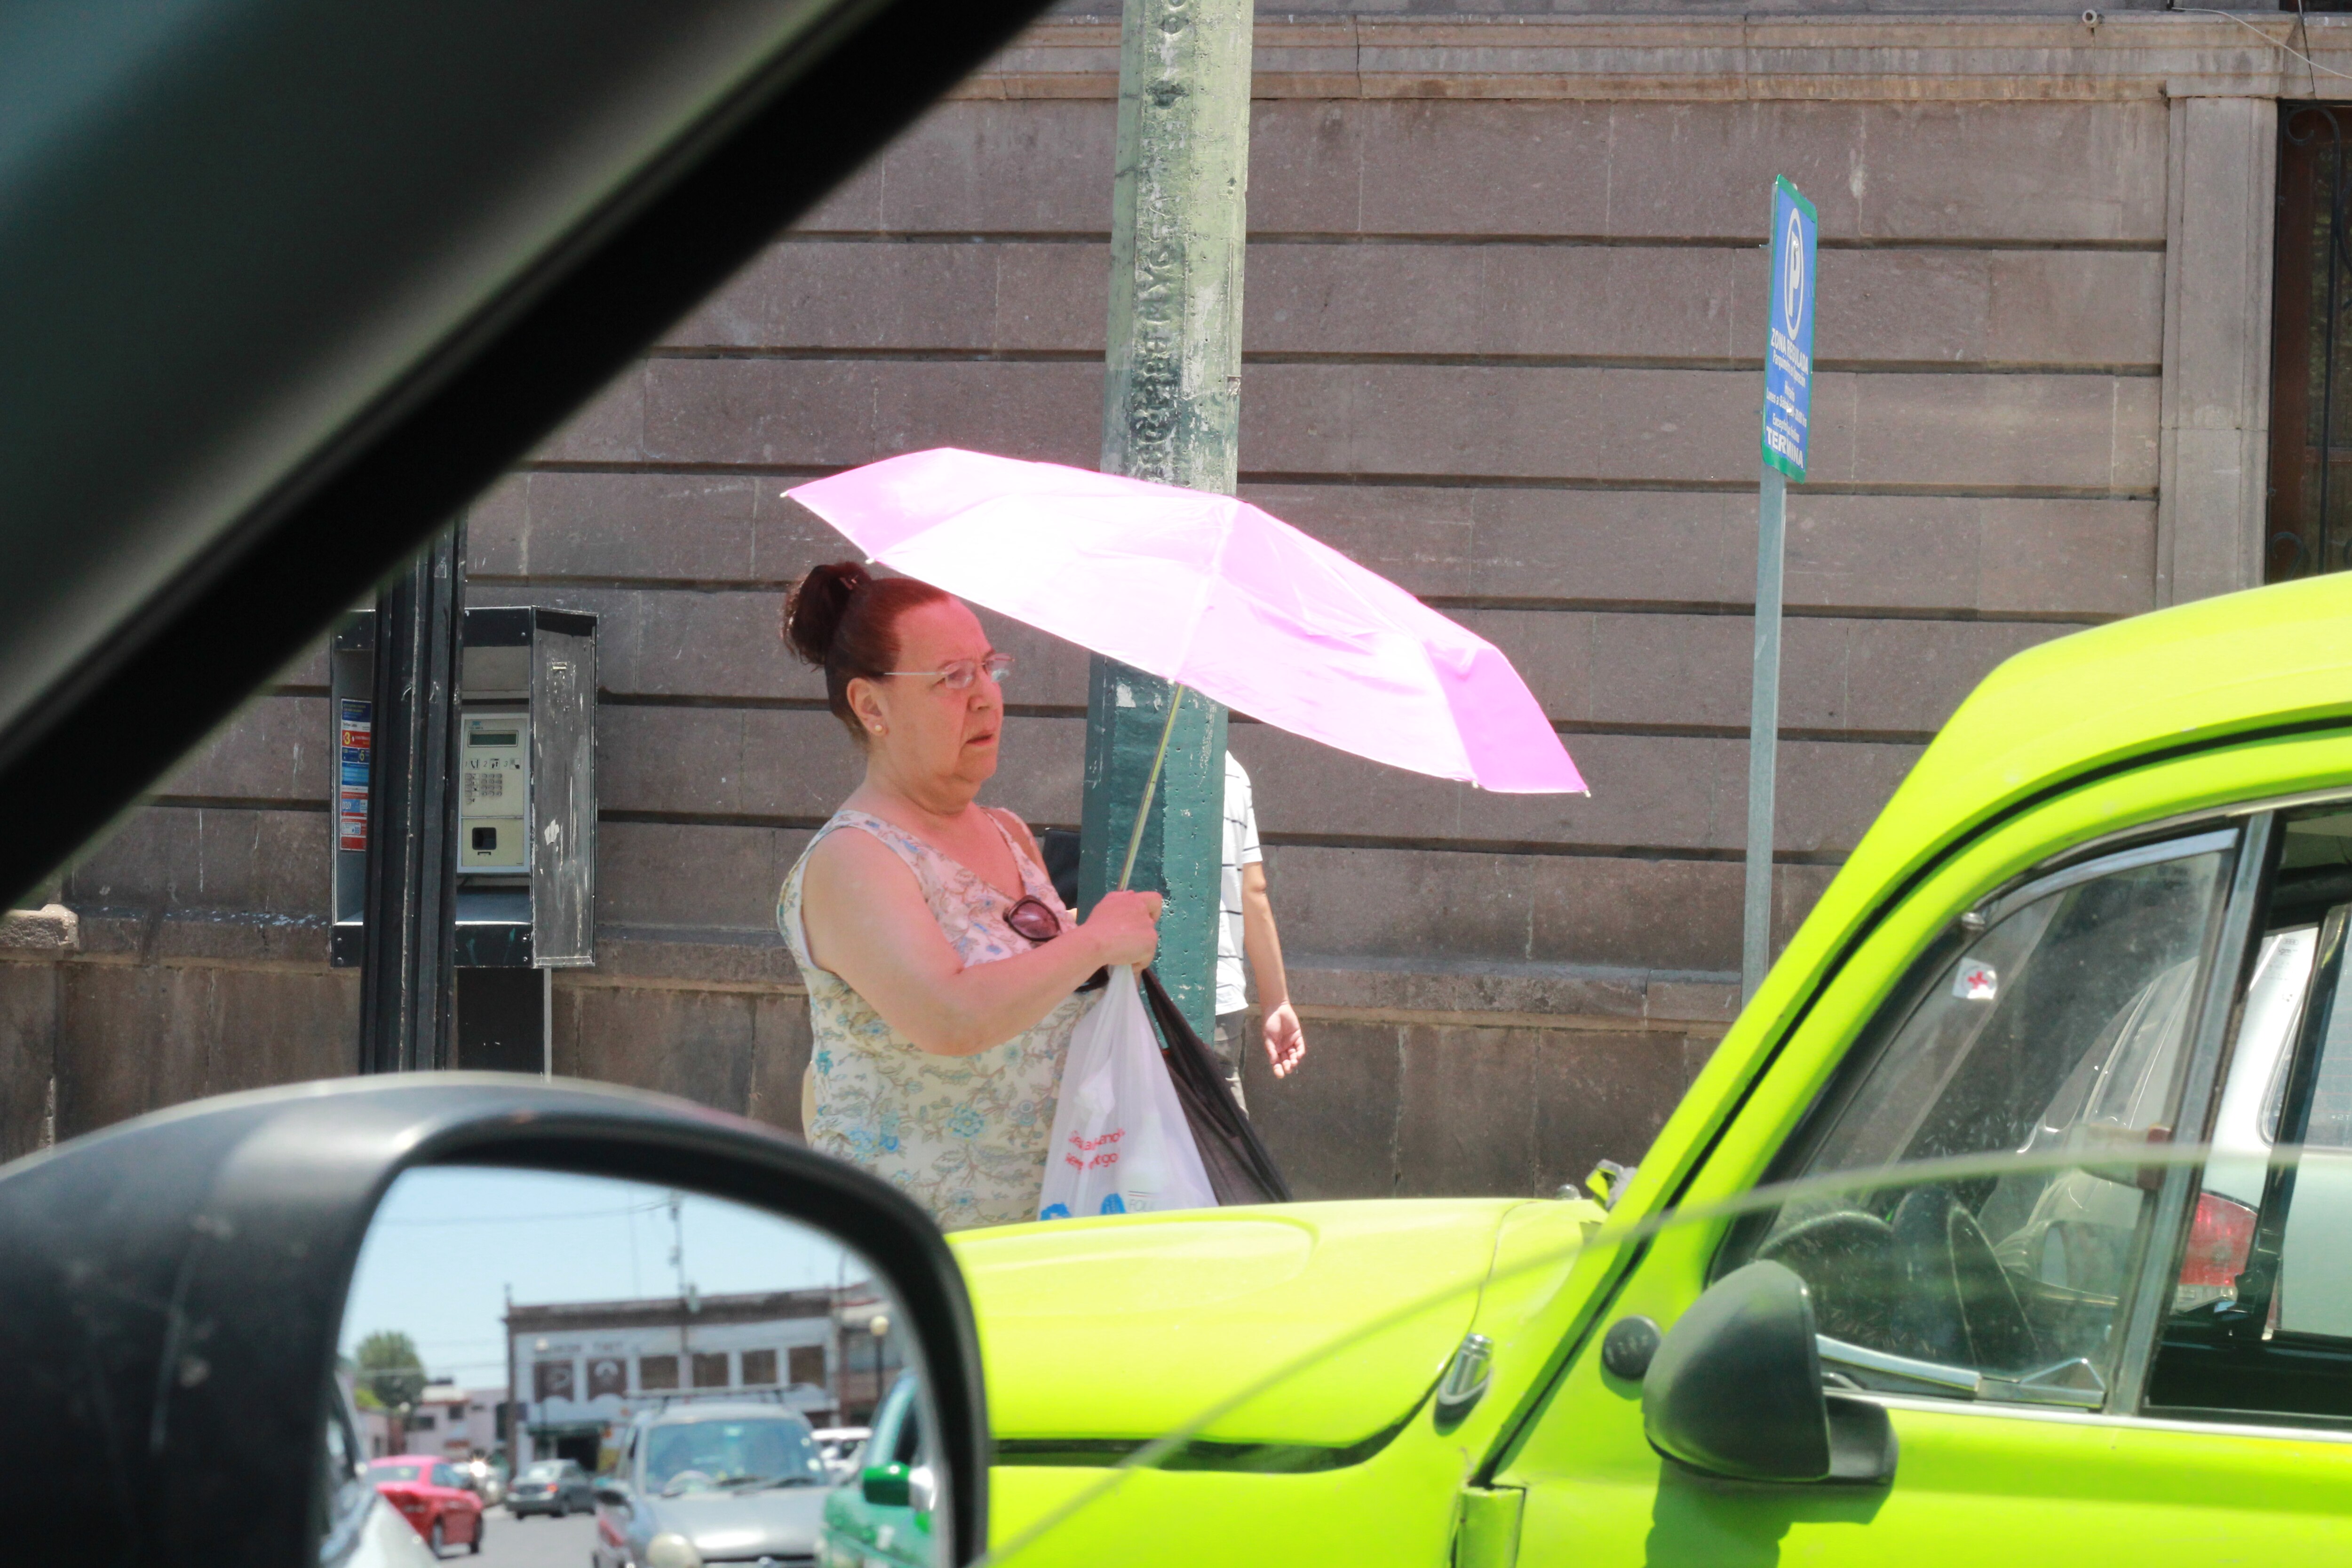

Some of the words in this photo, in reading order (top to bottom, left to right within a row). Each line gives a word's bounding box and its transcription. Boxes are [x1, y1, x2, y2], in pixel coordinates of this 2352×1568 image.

[1788, 230, 1800, 317] P
[1771, 327, 1787, 355] ZONA
[1766, 425, 1804, 469] TERMINA
